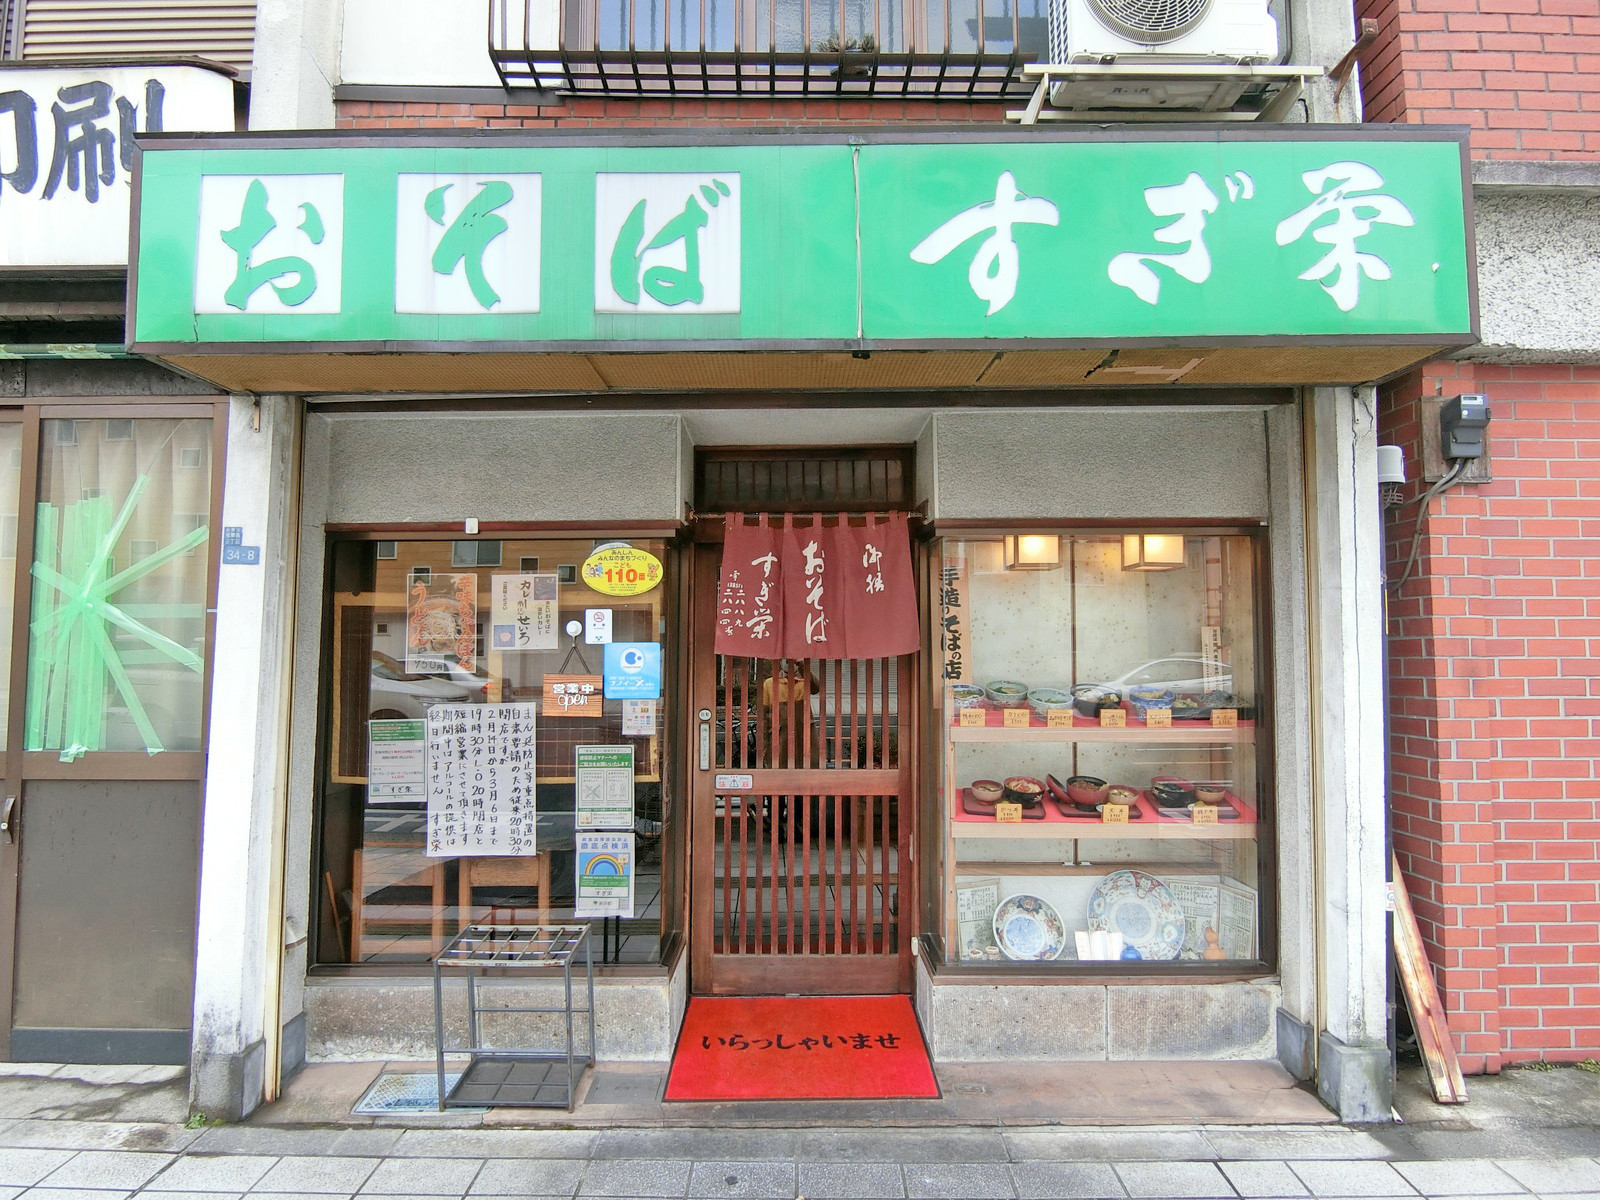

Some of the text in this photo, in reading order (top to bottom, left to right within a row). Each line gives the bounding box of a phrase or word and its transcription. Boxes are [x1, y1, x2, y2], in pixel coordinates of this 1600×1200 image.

[220, 160, 1415, 317] おそば すぎ栄
[227, 549, 255, 561] 34-8
[745, 551, 778, 640] すぎ栄
[802, 539, 830, 645] おそば
[410, 580, 431, 648] うどん
[455, 575, 474, 671] 辛味ちゃんぽん
[552, 682, 595, 695] 営業中
[557, 693, 589, 712] open
[429, 710, 443, 796] 終日行いません
[442, 709, 459, 847] 期間中はアルコールの提供は
[453, 709, 469, 846] 短縮営業にさせて頂きます
[487, 709, 499, 846] 2月14日から3月6日まで
[498, 708, 511, 766] 閉店ですが
[701, 1032, 901, 1051] いらっしゃいませ
